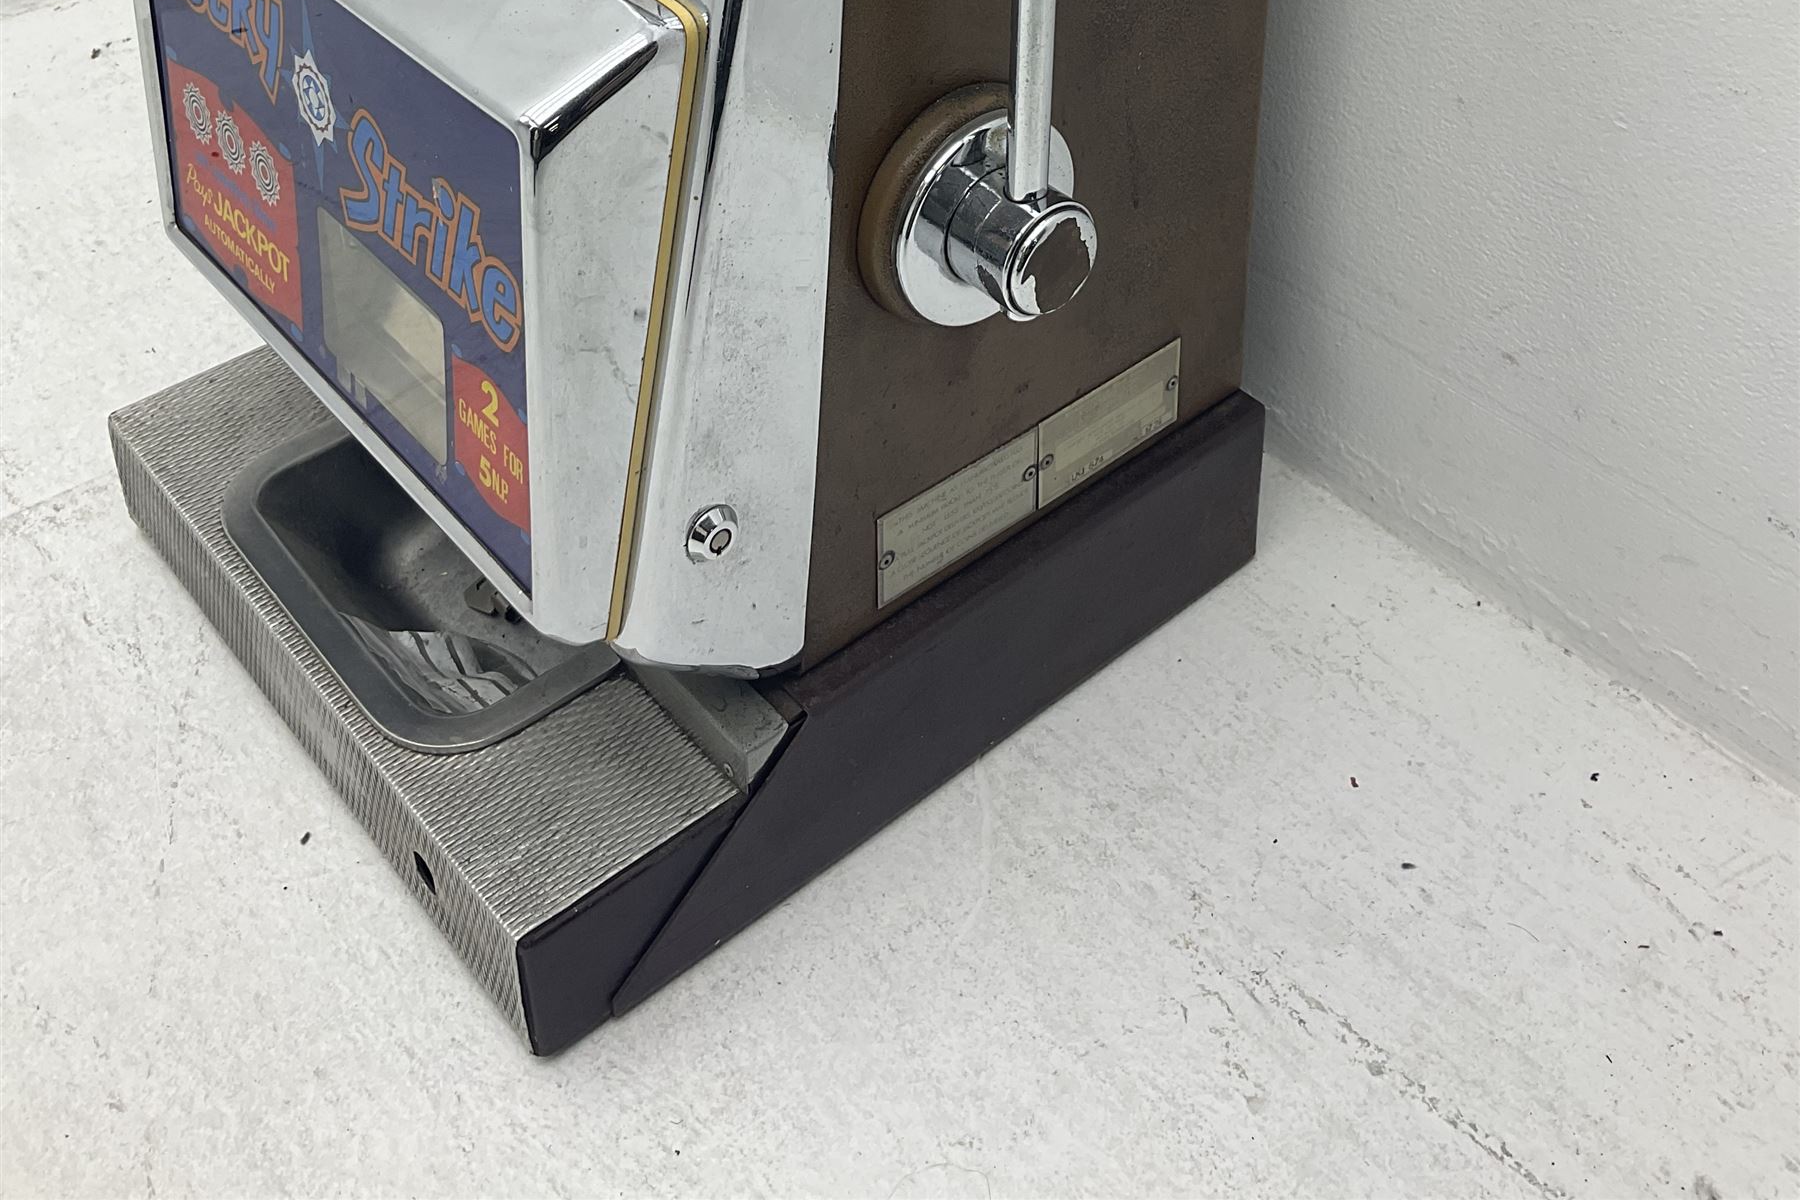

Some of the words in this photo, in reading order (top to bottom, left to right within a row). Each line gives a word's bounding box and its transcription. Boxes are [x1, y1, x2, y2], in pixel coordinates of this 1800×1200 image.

[186, 163, 214, 207] Pays
[213, 192, 290, 283] JACKPOT
[204, 214, 275, 294] AUTOMATICALLY
[339, 108, 522, 352] Strike
[458, 398, 497, 455] GAMES
[503, 443, 524, 485] FOR
[481, 380, 499, 428] 2
